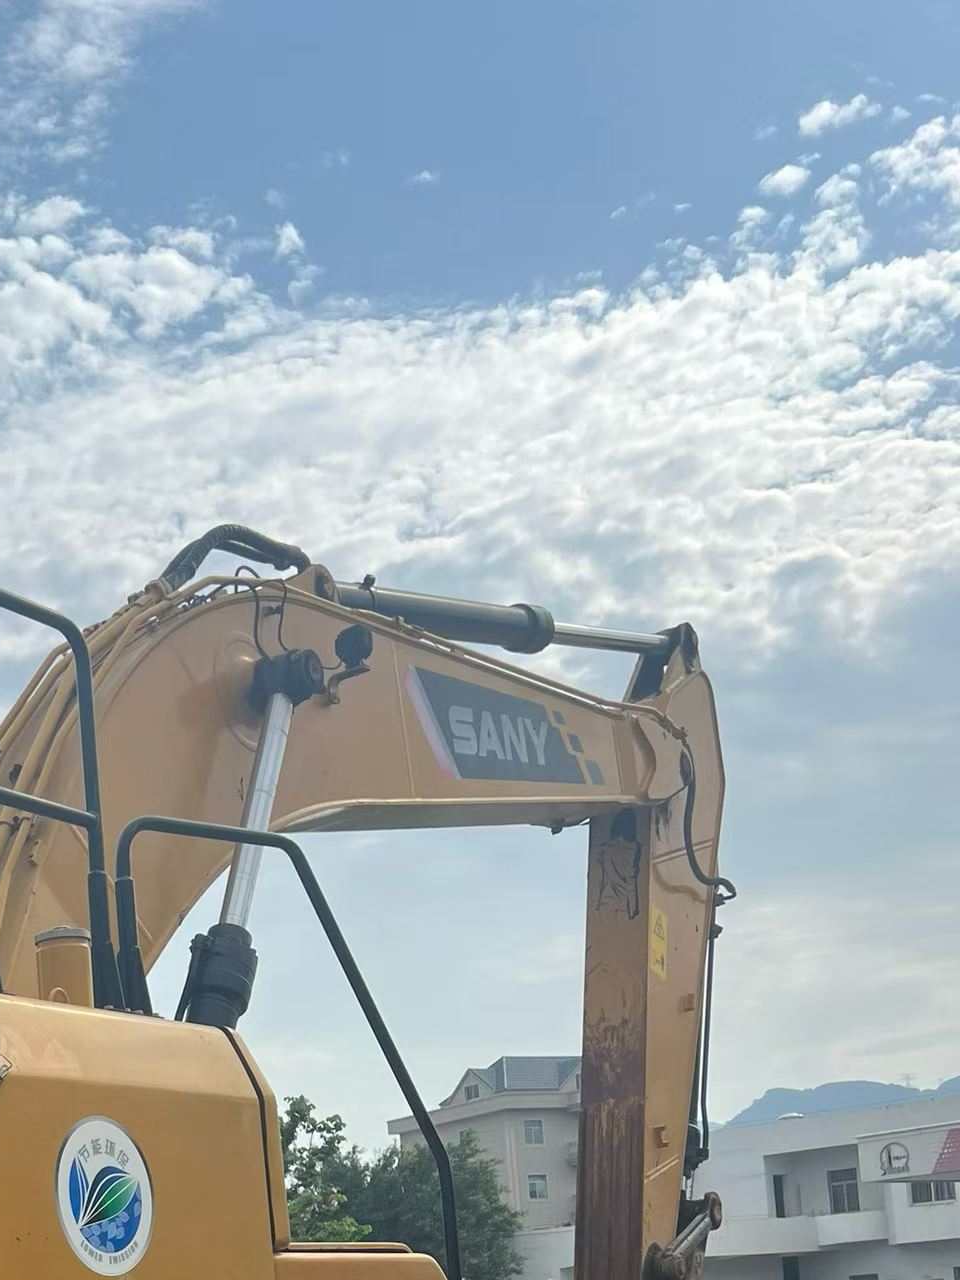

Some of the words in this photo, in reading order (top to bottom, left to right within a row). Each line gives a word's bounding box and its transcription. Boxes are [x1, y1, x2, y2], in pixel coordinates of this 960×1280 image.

[448, 705, 548, 766] SANY
[80, 1240, 103, 1263] LOWER
[109, 1240, 139, 1264] EMISSION
